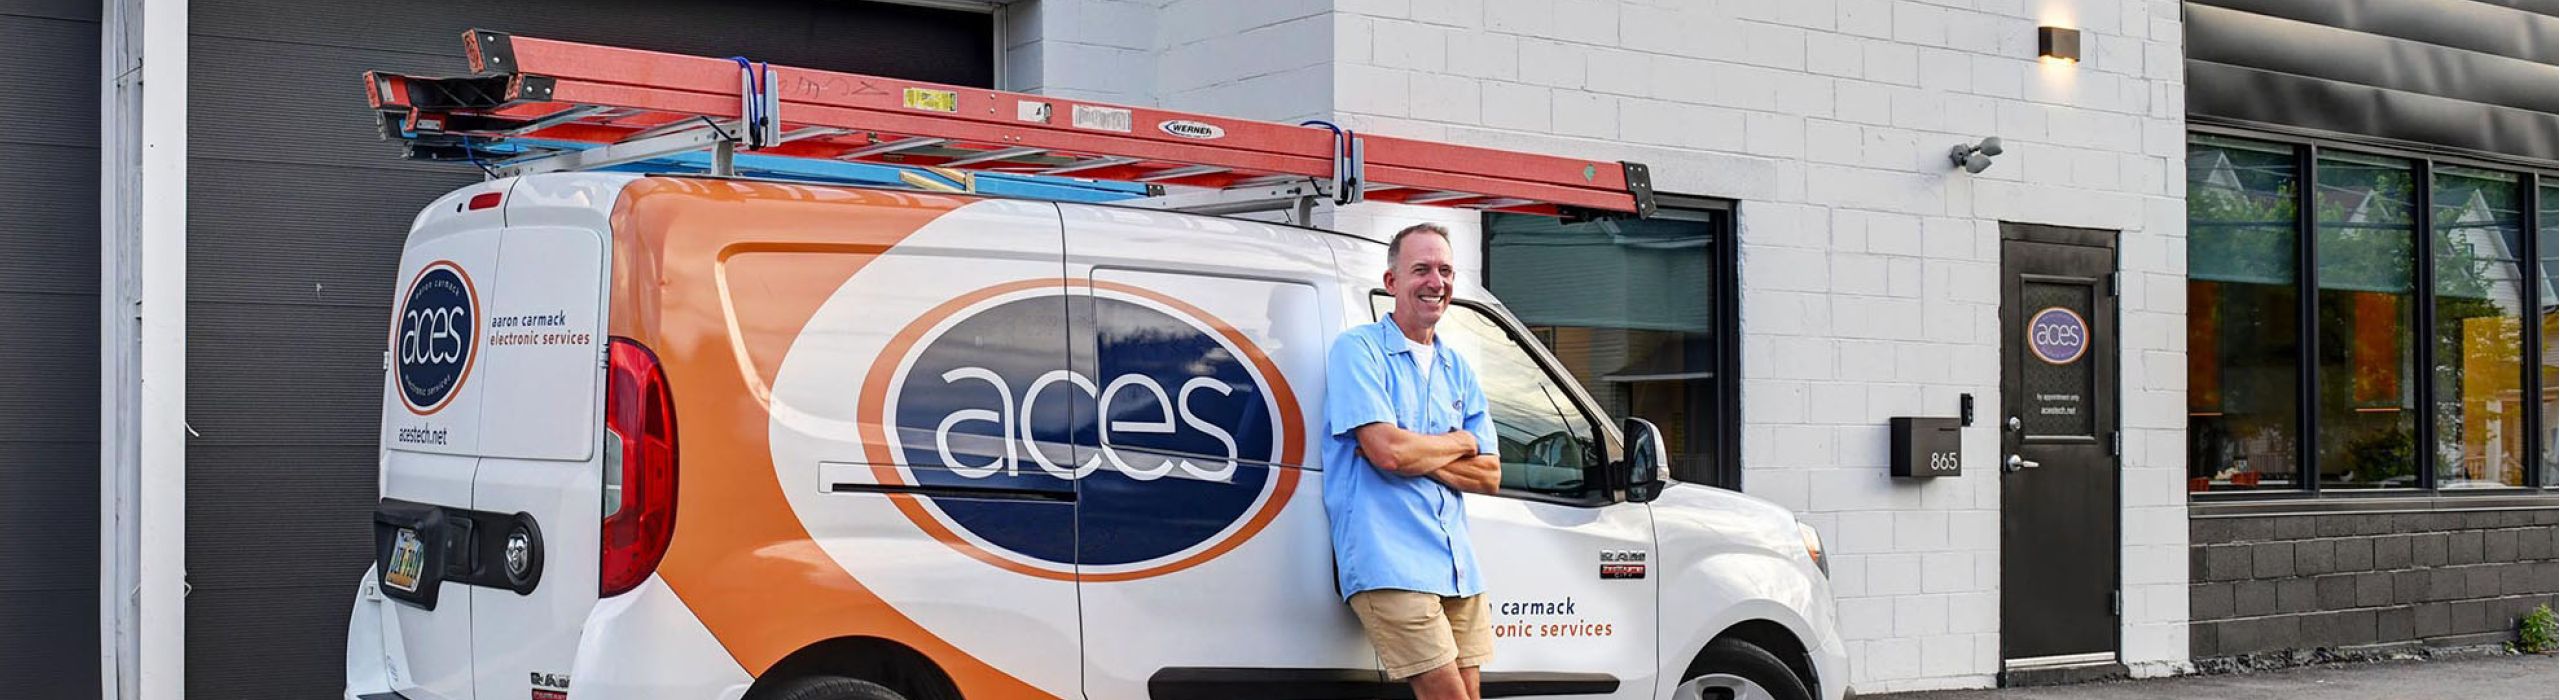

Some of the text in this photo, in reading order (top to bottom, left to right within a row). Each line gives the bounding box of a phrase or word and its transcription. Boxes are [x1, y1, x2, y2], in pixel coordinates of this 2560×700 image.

[1172, 123, 1212, 136] WERNER
[491, 309, 566, 328] aaron carmack
[403, 306, 464, 364] aces
[490, 329, 590, 346] electronic services
[2036, 323, 2080, 346] aces
[935, 366, 1238, 481] aces
[399, 422, 447, 445] acestech.net
[1930, 452, 1958, 470] 865
[1600, 550, 1646, 561] RAM
[1501, 596, 1575, 615] carmack
[1540, 619, 1612, 637] services
